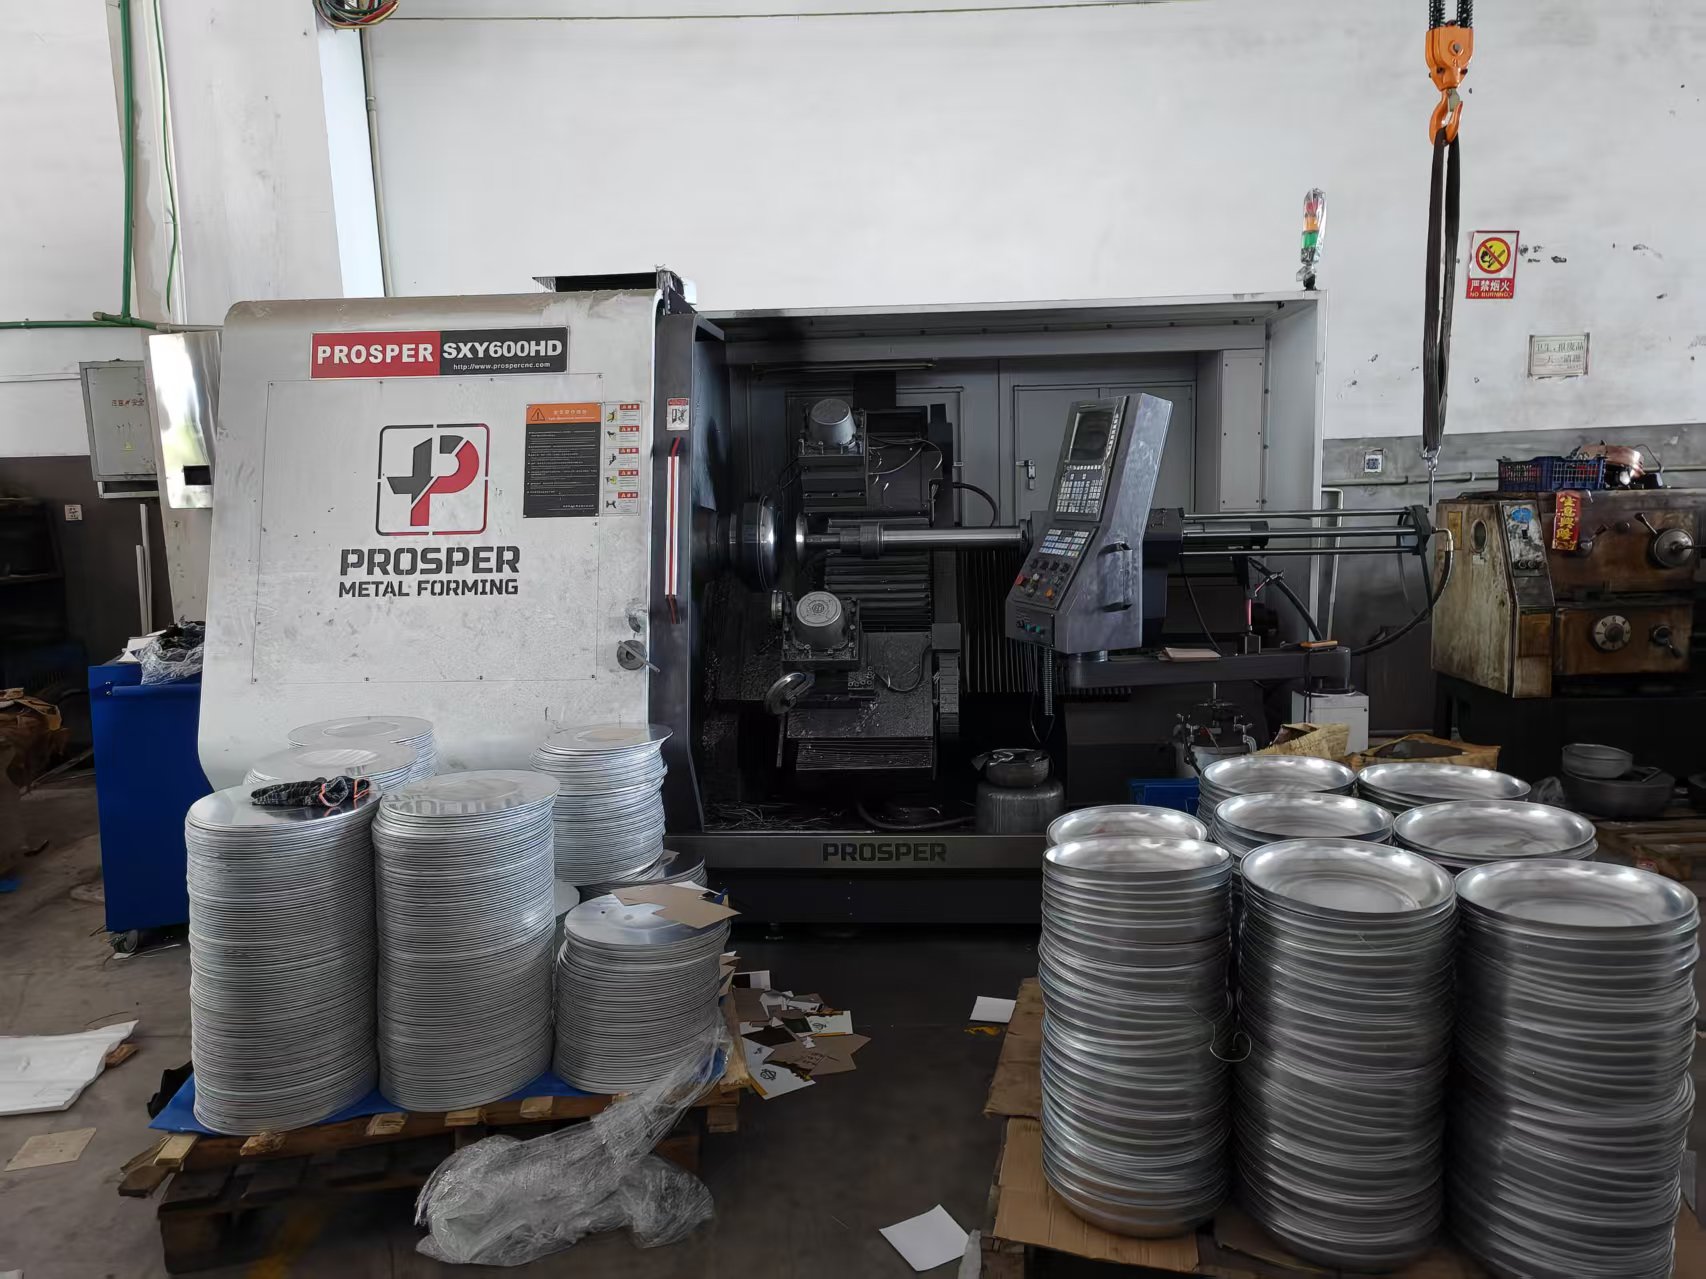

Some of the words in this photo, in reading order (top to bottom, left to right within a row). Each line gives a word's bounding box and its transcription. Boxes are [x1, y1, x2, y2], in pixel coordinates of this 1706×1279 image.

[1471, 280, 1509, 291] 严禁烟火
[317, 343, 434, 364] PROSPER
[442, 340, 563, 359] SXY600HD
[453, 362, 551, 370] http://www.prospercnc.com
[340, 545, 521, 576] PROSPER
[339, 580, 410, 598] METAL
[417, 578, 519, 597] FORMING
[822, 842, 947, 862] PROSPER
